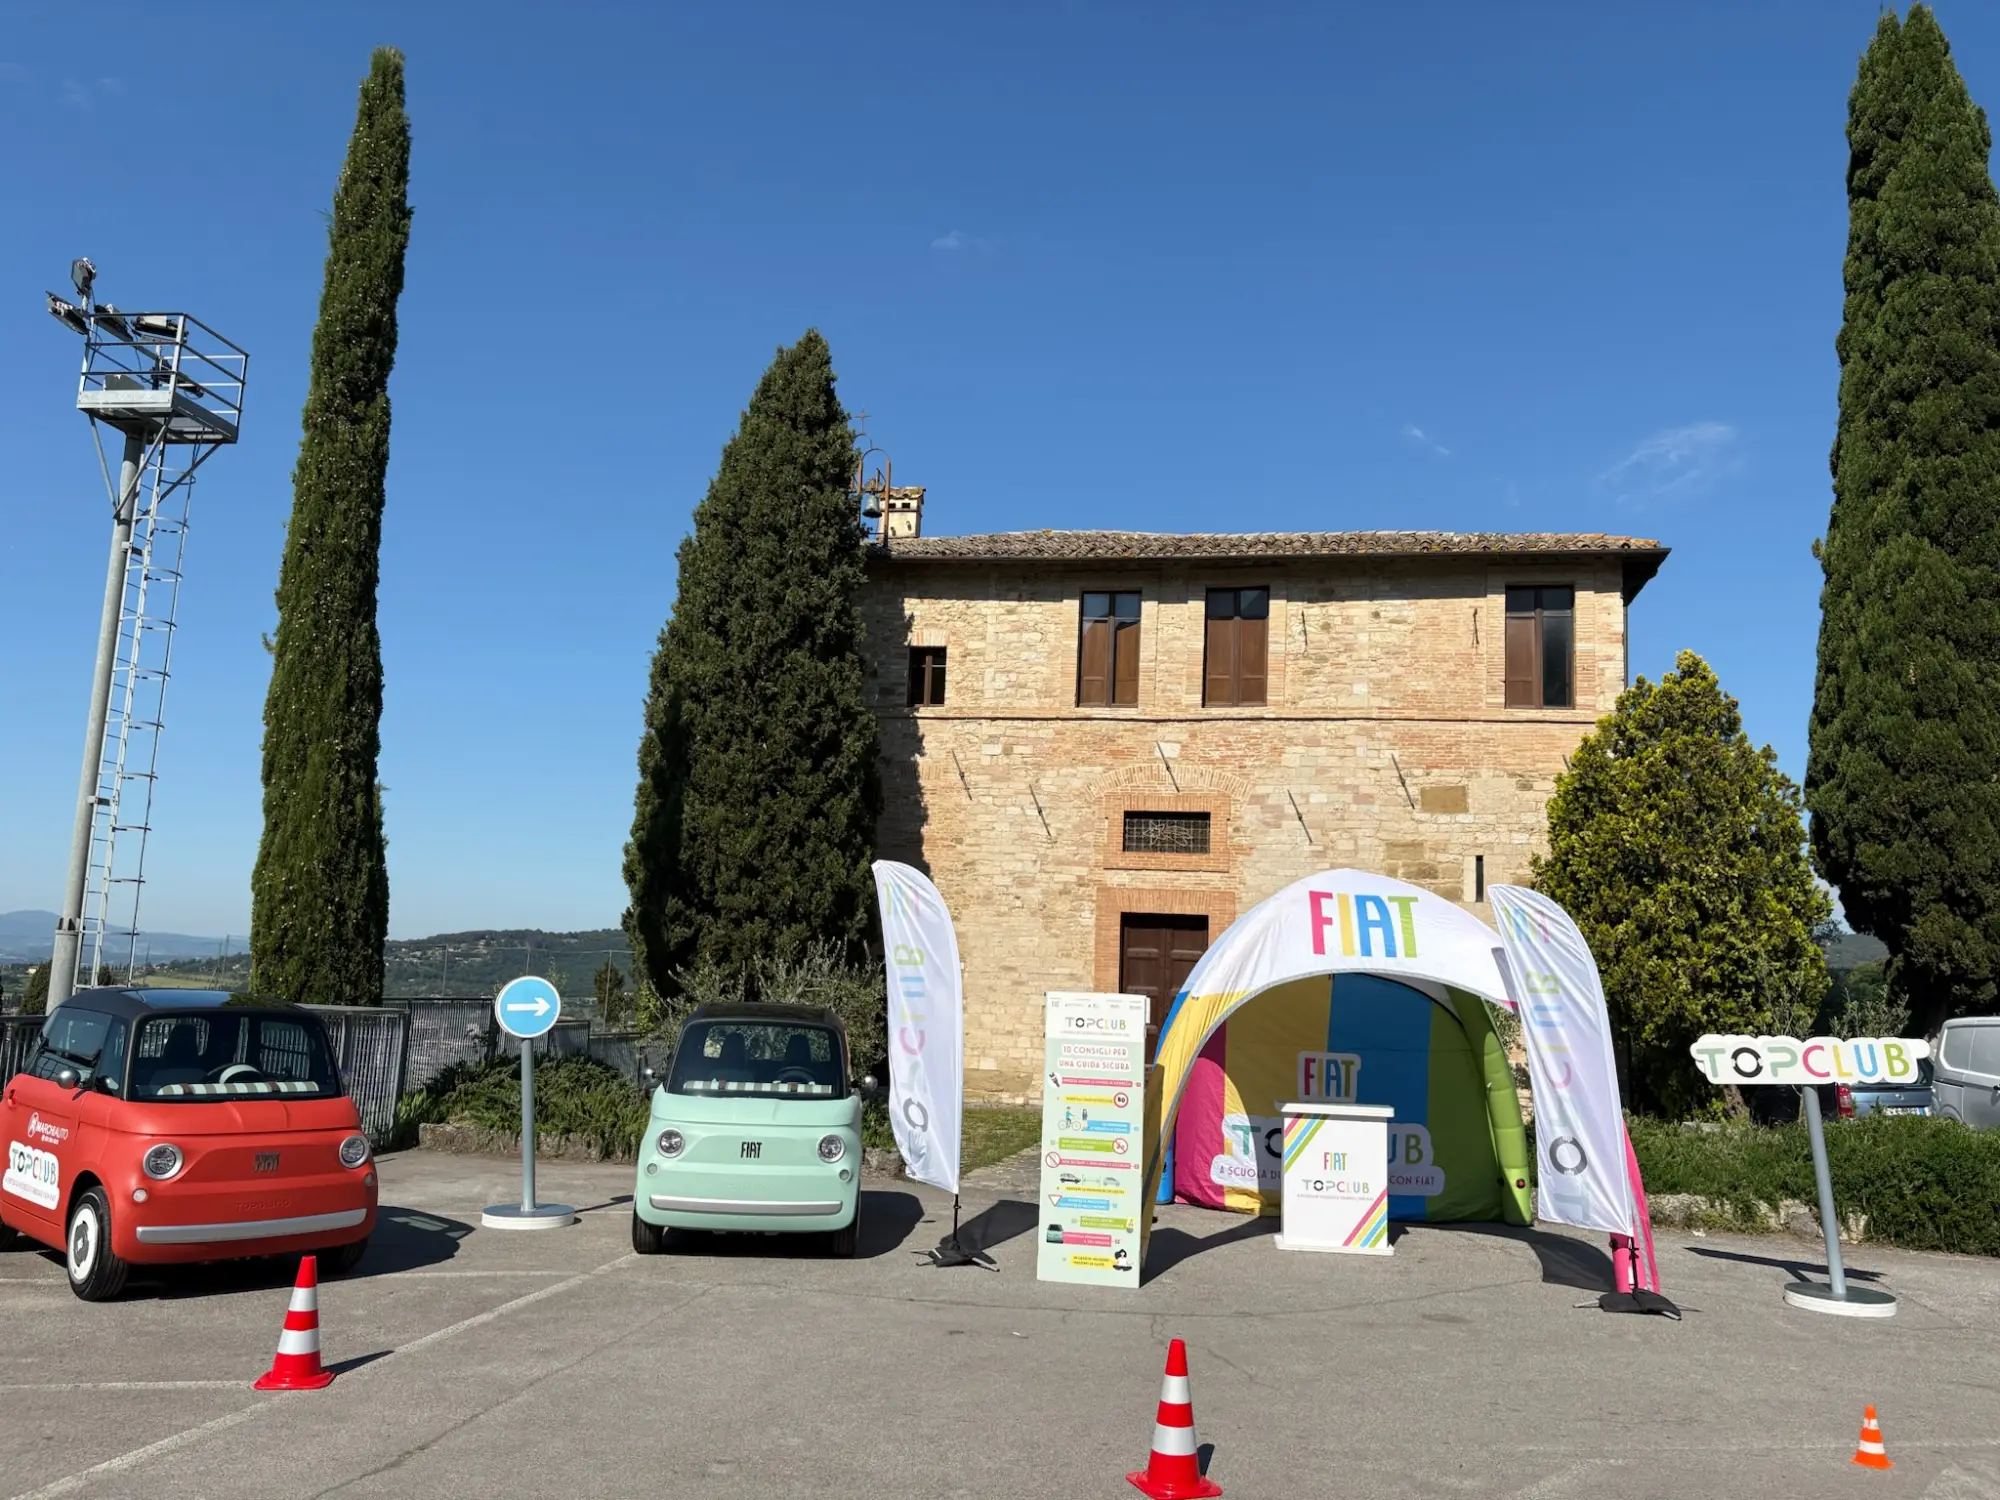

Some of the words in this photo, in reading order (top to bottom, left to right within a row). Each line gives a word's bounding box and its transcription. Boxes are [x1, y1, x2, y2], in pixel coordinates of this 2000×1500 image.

[1309, 890, 1419, 958] FIAT
[1065, 1017, 1127, 1030] TOPCLUB
[1073, 1046, 1110, 1055] CONSIGLI
[1113, 1048, 1127, 1056] PER
[1102, 1062, 1129, 1070] SICURA
[1696, 1043, 1910, 1078] TOPCLUB
[1304, 1057, 1355, 1098] FIAT
[741, 1141, 763, 1159] FIAT
[12, 1148, 57, 1185] TOPCLUB
[1323, 1152, 1347, 1171] FIAT
[1228, 1166, 1267, 1179] SCUOLA
[1389, 1175, 1412, 1185] CON
[1415, 1175, 1436, 1185] FIAT
[1301, 1179, 1370, 1194] TOPCLUB
